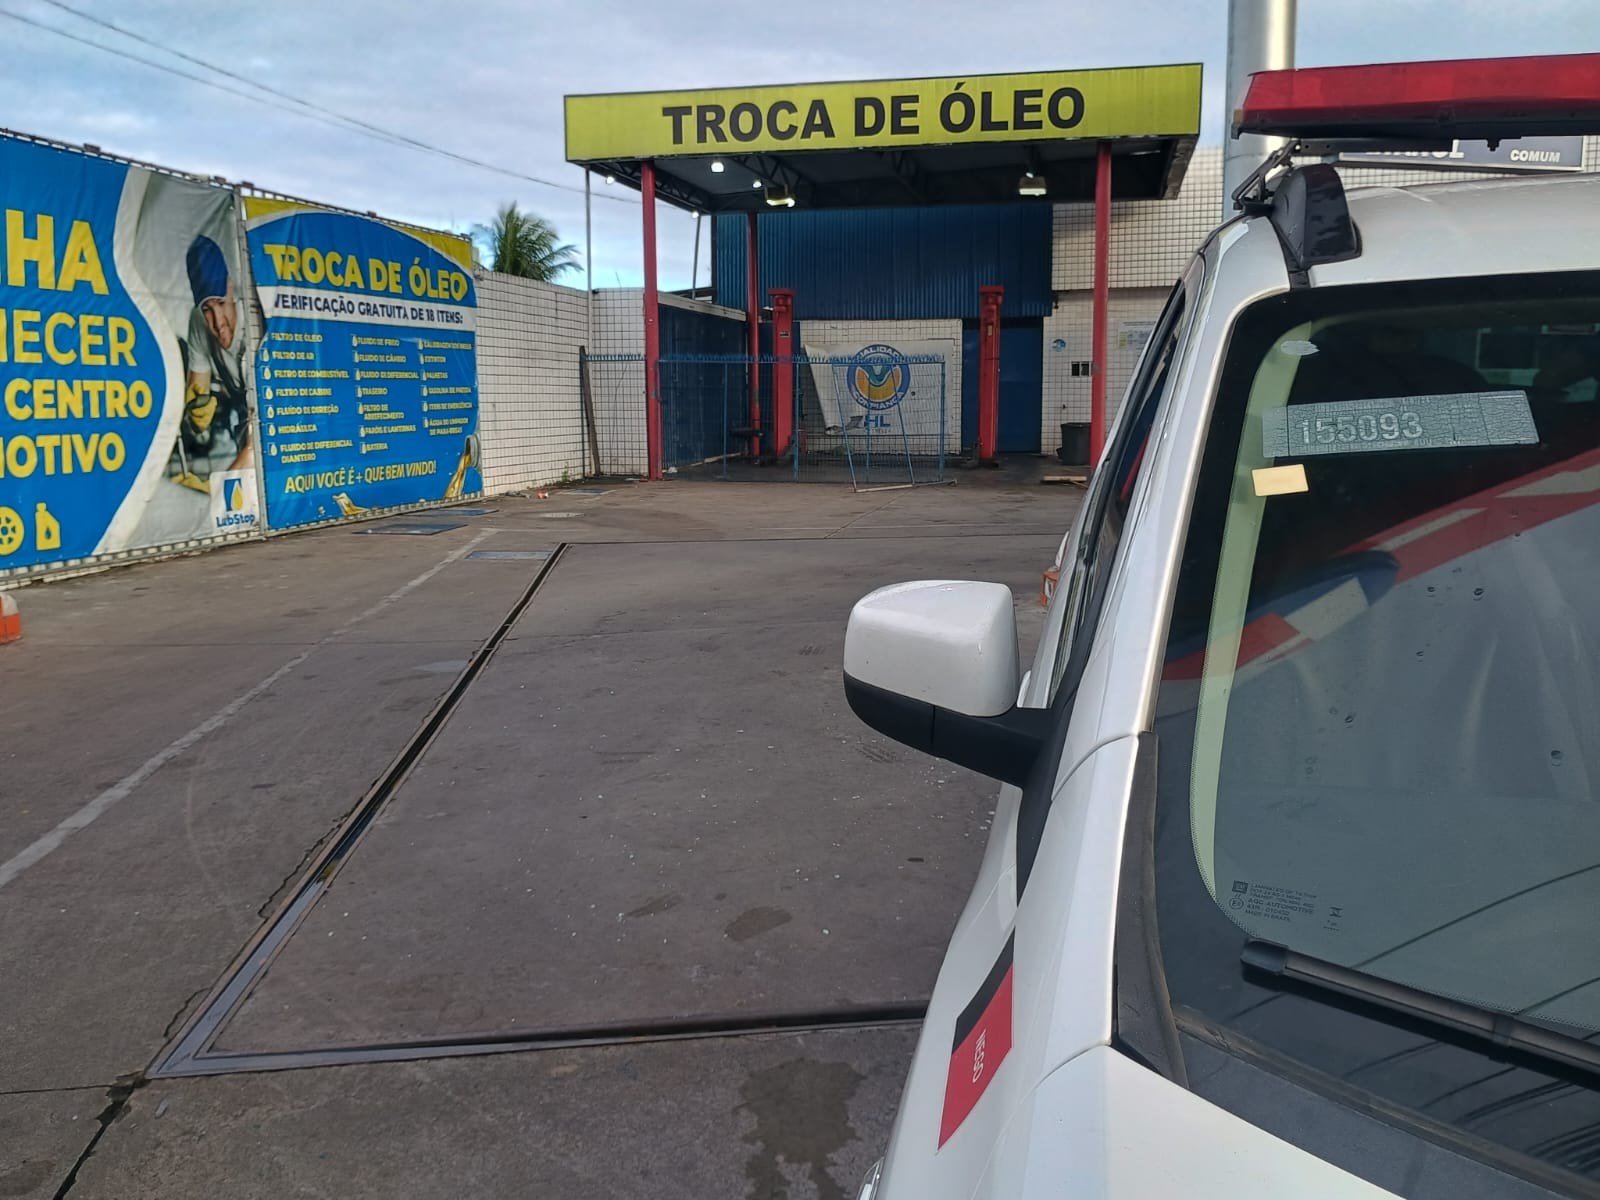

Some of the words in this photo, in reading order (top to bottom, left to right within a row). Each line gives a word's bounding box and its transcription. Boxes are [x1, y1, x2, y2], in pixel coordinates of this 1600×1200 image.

[662, 99, 836, 145] TROCA
[854, 94, 920, 137] DE
[939, 82, 1085, 133] ÓLEO
[1510, 149, 1561, 163] COMUM
[0, 209, 110, 296] HA
[263, 244, 365, 289] TROCA
[369, 258, 403, 294] DE
[409, 257, 469, 302] ÓLEO
[274, 293, 355, 318] VERIFICAÇÃO
[358, 302, 409, 321] GRATUITA
[411, 309, 425, 322] DE
[425, 309, 435, 322] 18
[437, 311, 464, 325] ITENS:
[4, 378, 153, 421] CENTRO
[1303, 412, 1423, 444] 155093
[0, 432, 126, 480] OTIVO
[285, 474, 315, 493] AQUI
[316, 467, 346, 488] VOCÊ
[348, 466, 355, 485] É
[364, 466, 385, 484] QUE
[386, 464, 405, 480] BEM
[406, 460, 437, 477] VINDO!
[215, 514, 256, 528] LubStop
